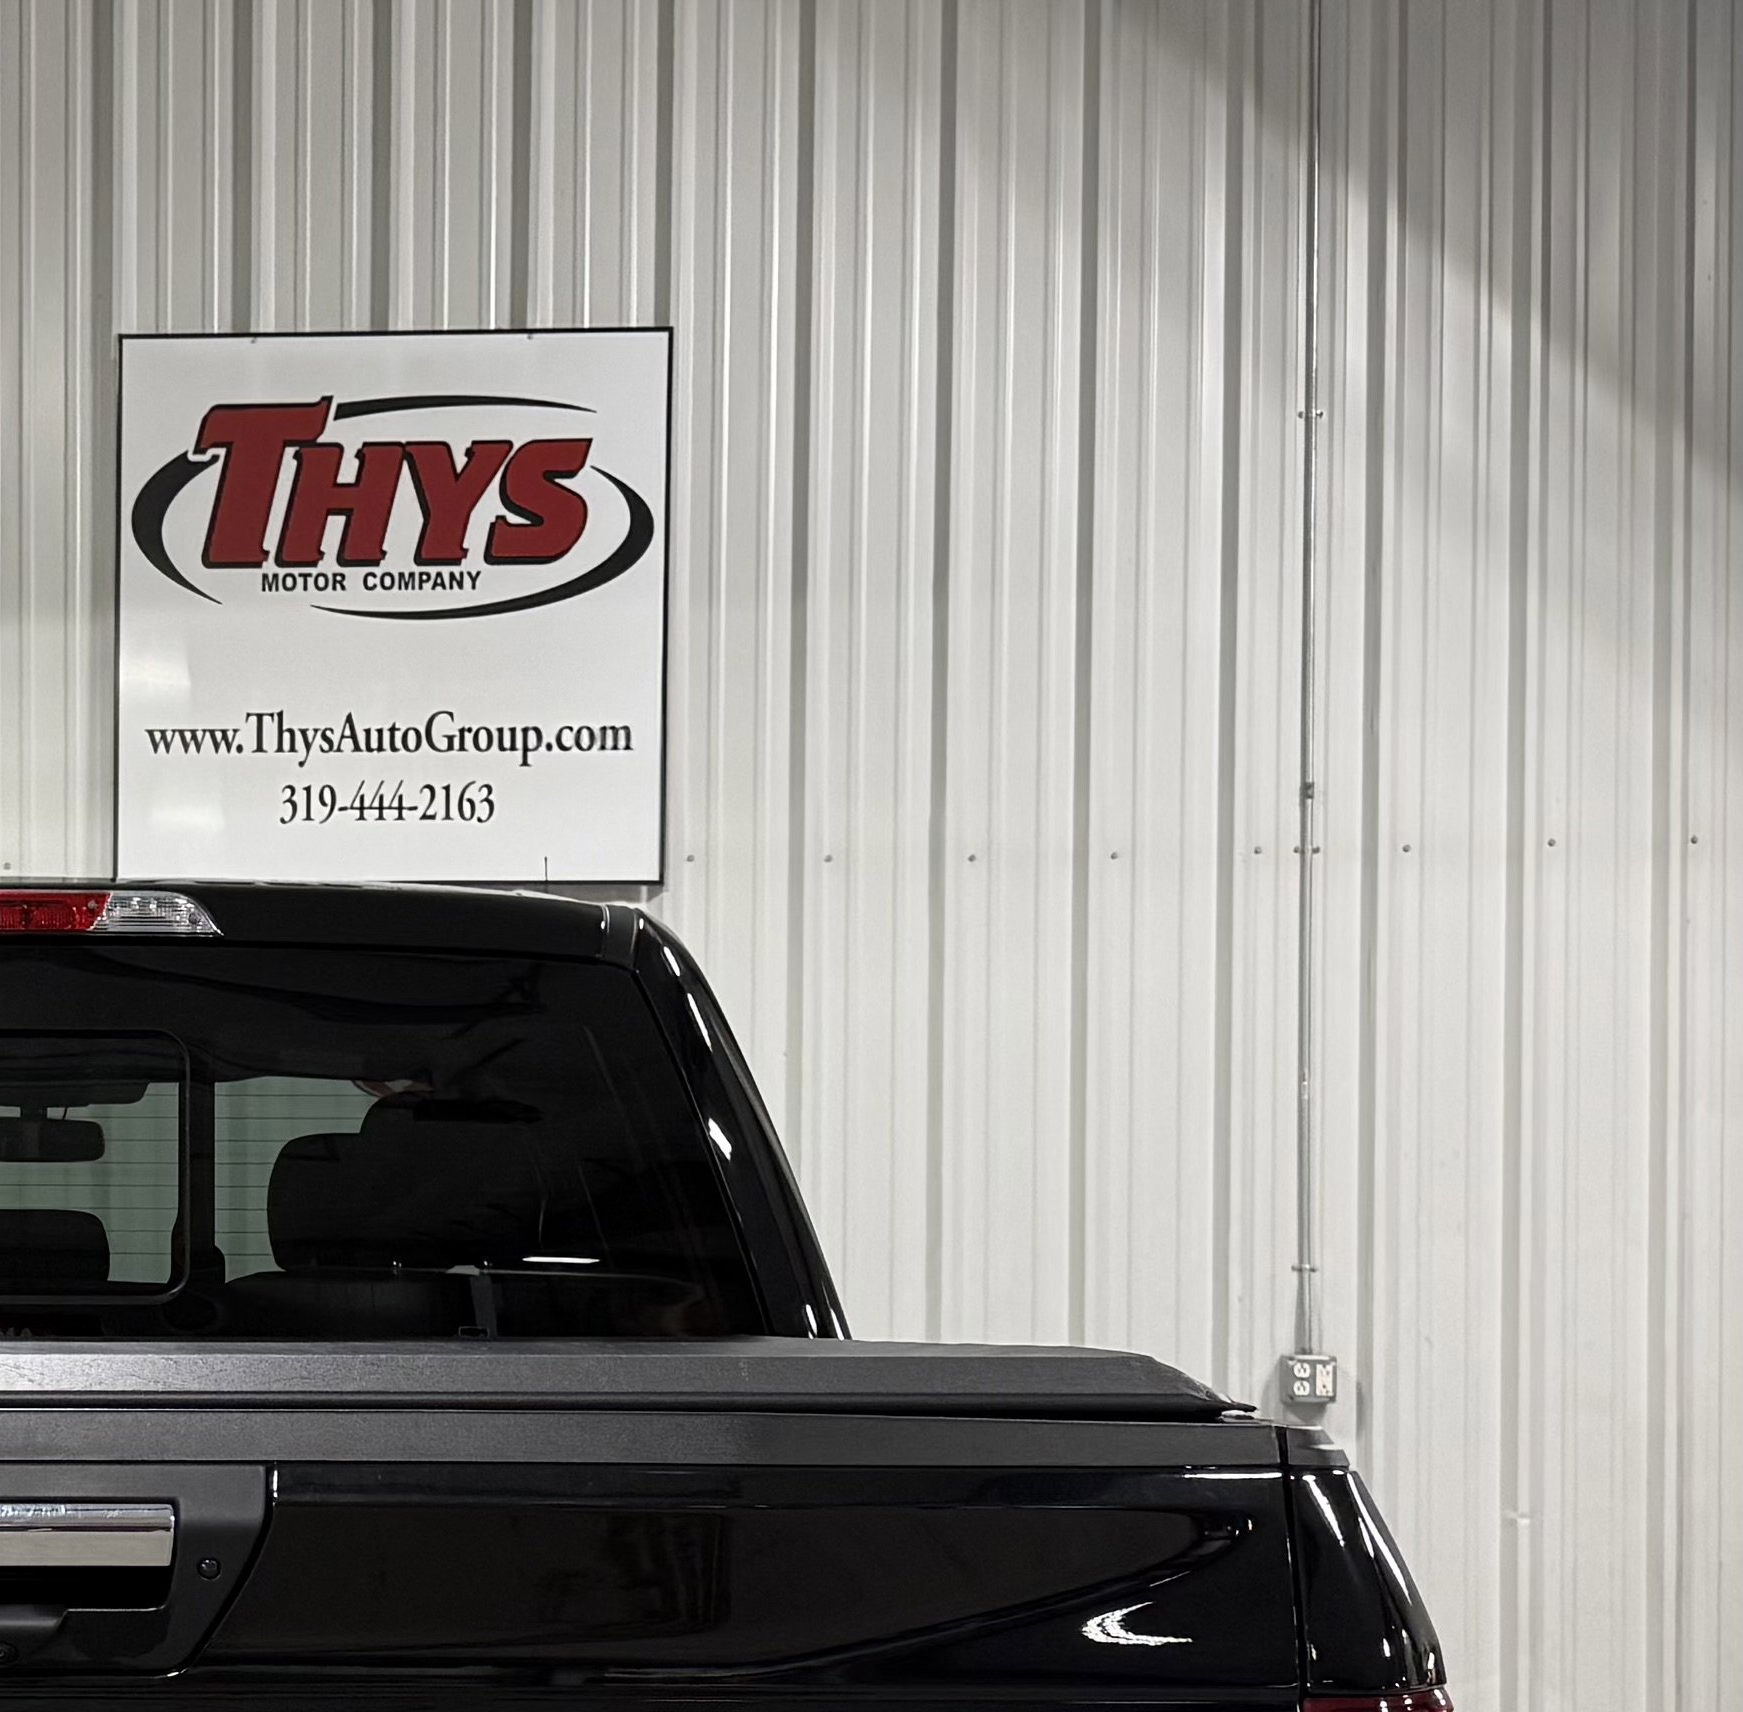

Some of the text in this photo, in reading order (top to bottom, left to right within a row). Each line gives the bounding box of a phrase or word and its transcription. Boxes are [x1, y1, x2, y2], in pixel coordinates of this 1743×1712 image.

[193, 395, 593, 569] THYS
[261, 571, 482, 592] MOTOR COMPANY
[145, 711, 634, 767] www.ThysAutoGroup.com
[279, 780, 496, 824] 319-444-2163
